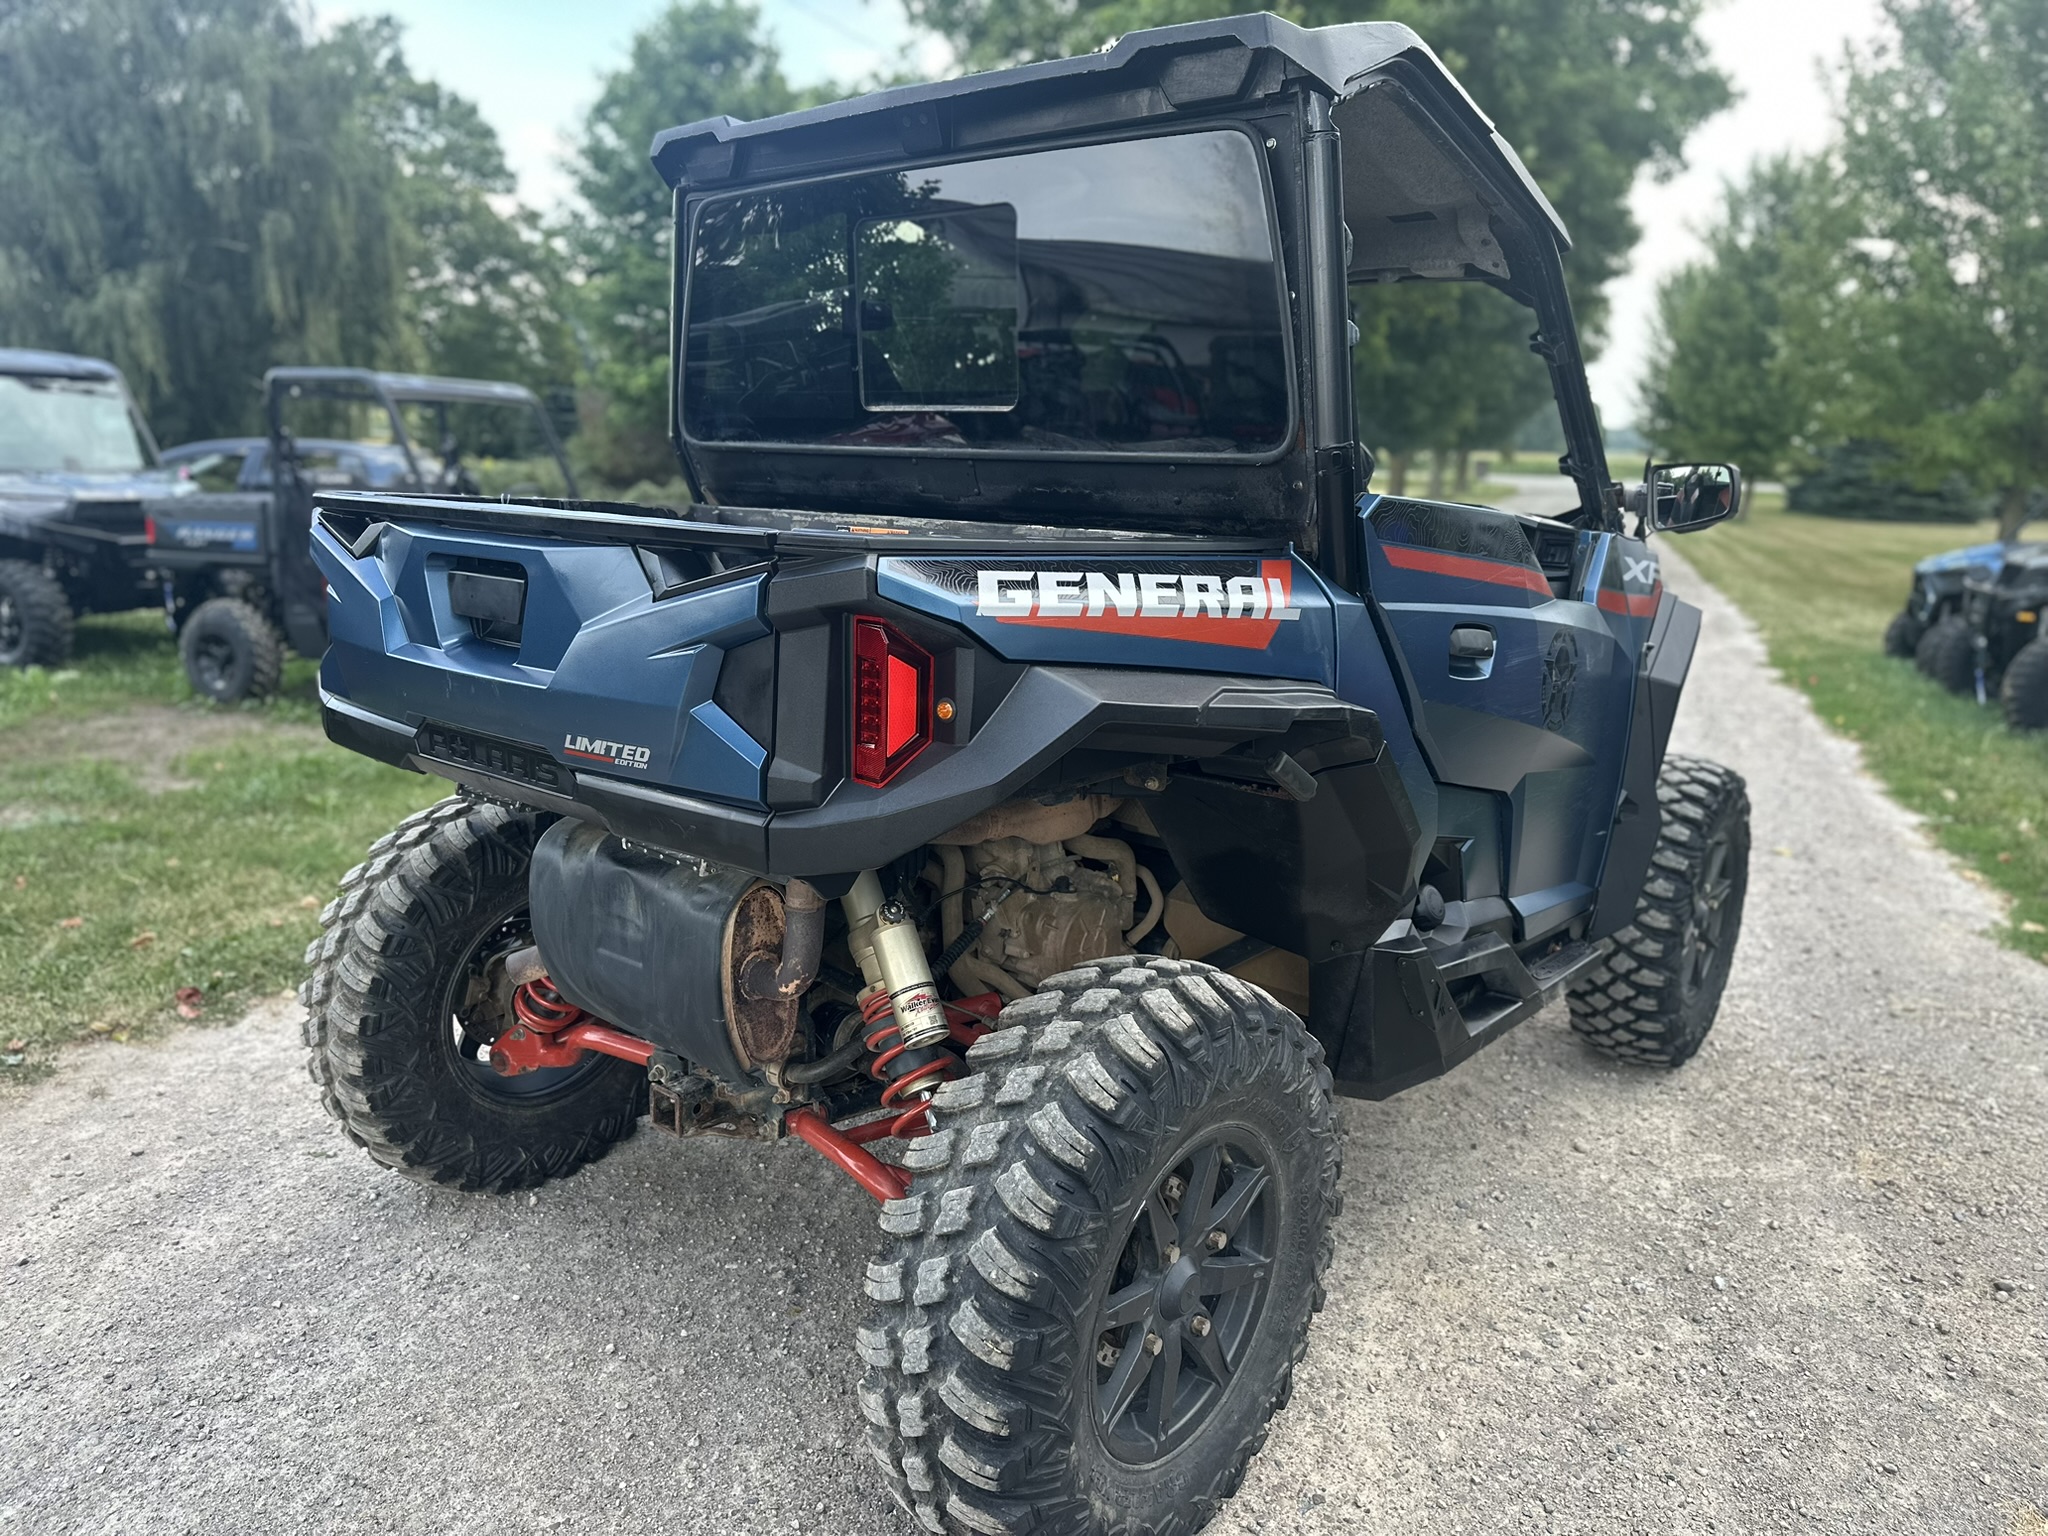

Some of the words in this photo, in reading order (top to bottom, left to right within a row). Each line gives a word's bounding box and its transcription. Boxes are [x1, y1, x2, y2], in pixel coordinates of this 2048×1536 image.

[975, 569, 1302, 621] GENERAL
[428, 727, 559, 788] POLARIS
[563, 733, 651, 762] LIMITED
[614, 757, 649, 770] EDITION
[900, 998, 927, 1014] Walker
